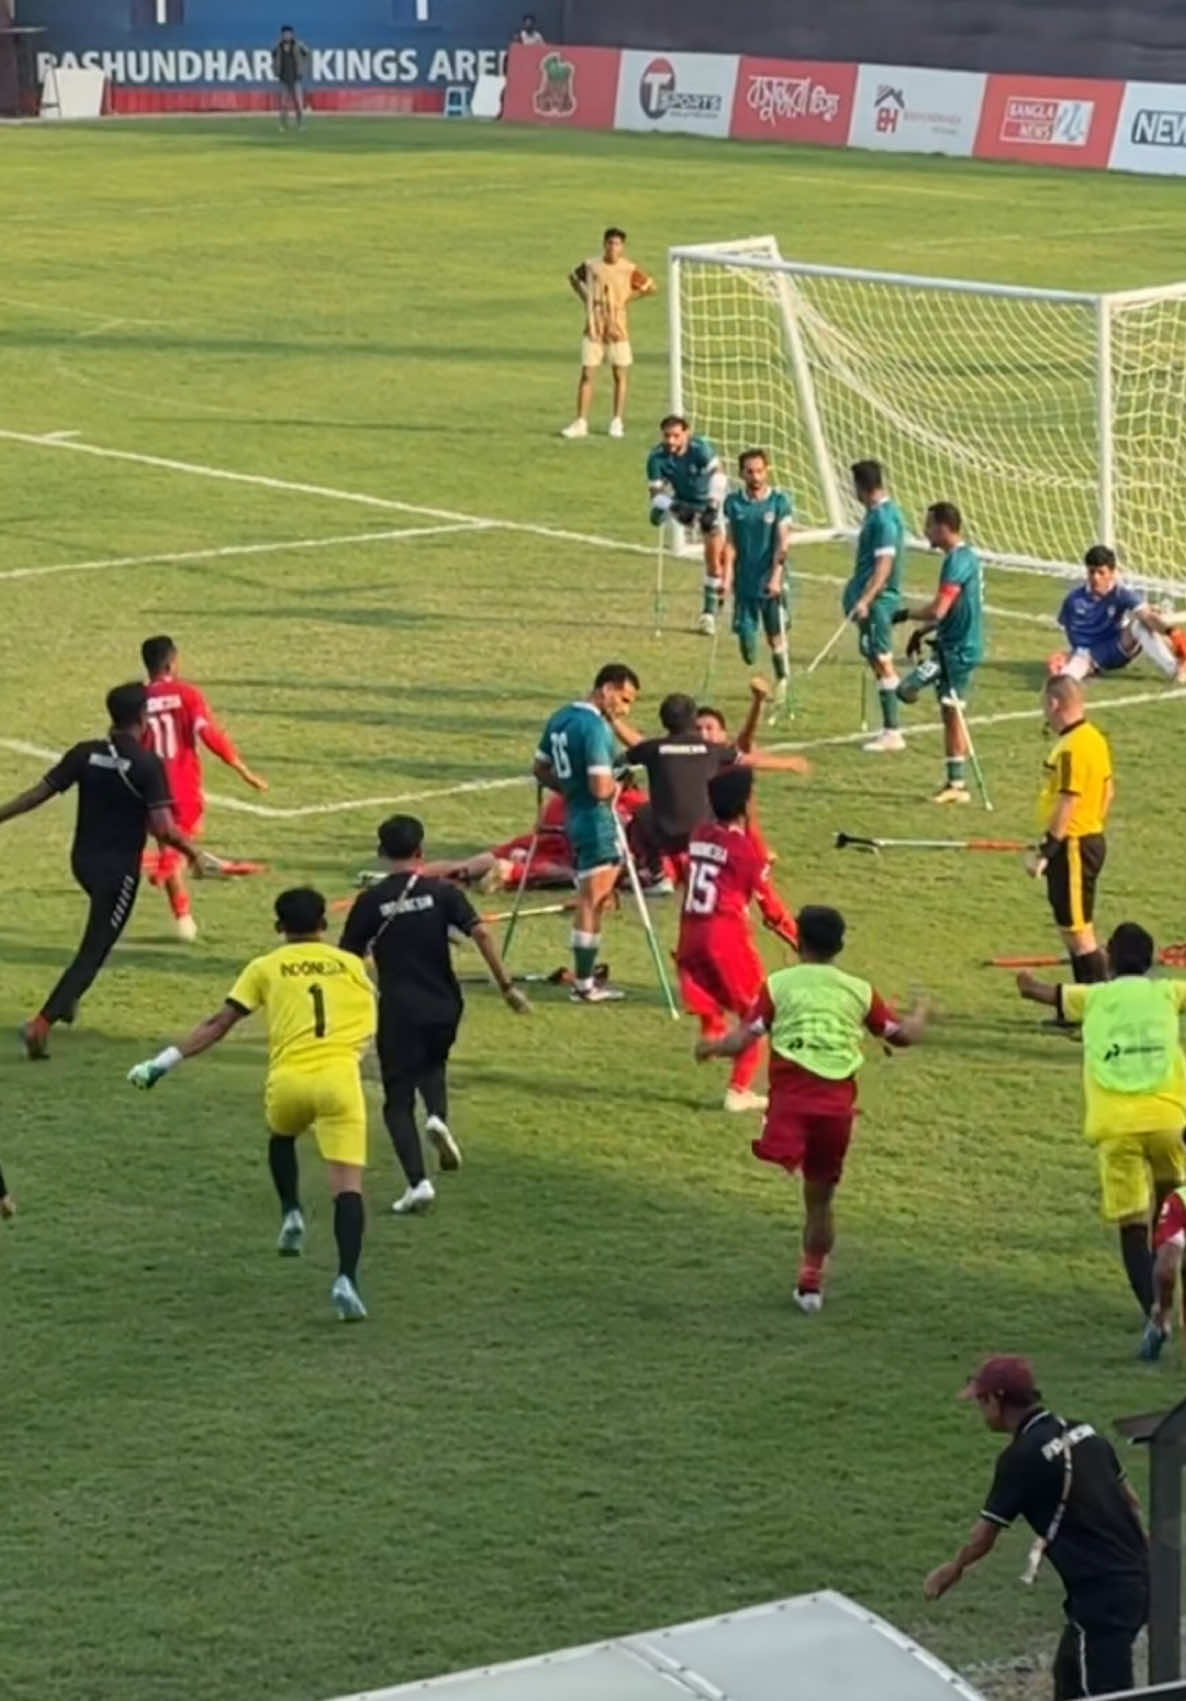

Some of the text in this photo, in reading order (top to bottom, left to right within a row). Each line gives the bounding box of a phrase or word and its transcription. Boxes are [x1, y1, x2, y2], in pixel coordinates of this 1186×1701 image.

[37, 50, 280, 82] BASHUNDHAR
[312, 49, 418, 82] KINGS
[146, 712, 176, 758] 11
[686, 862, 719, 913] 15
[308, 982, 325, 1038] 1
